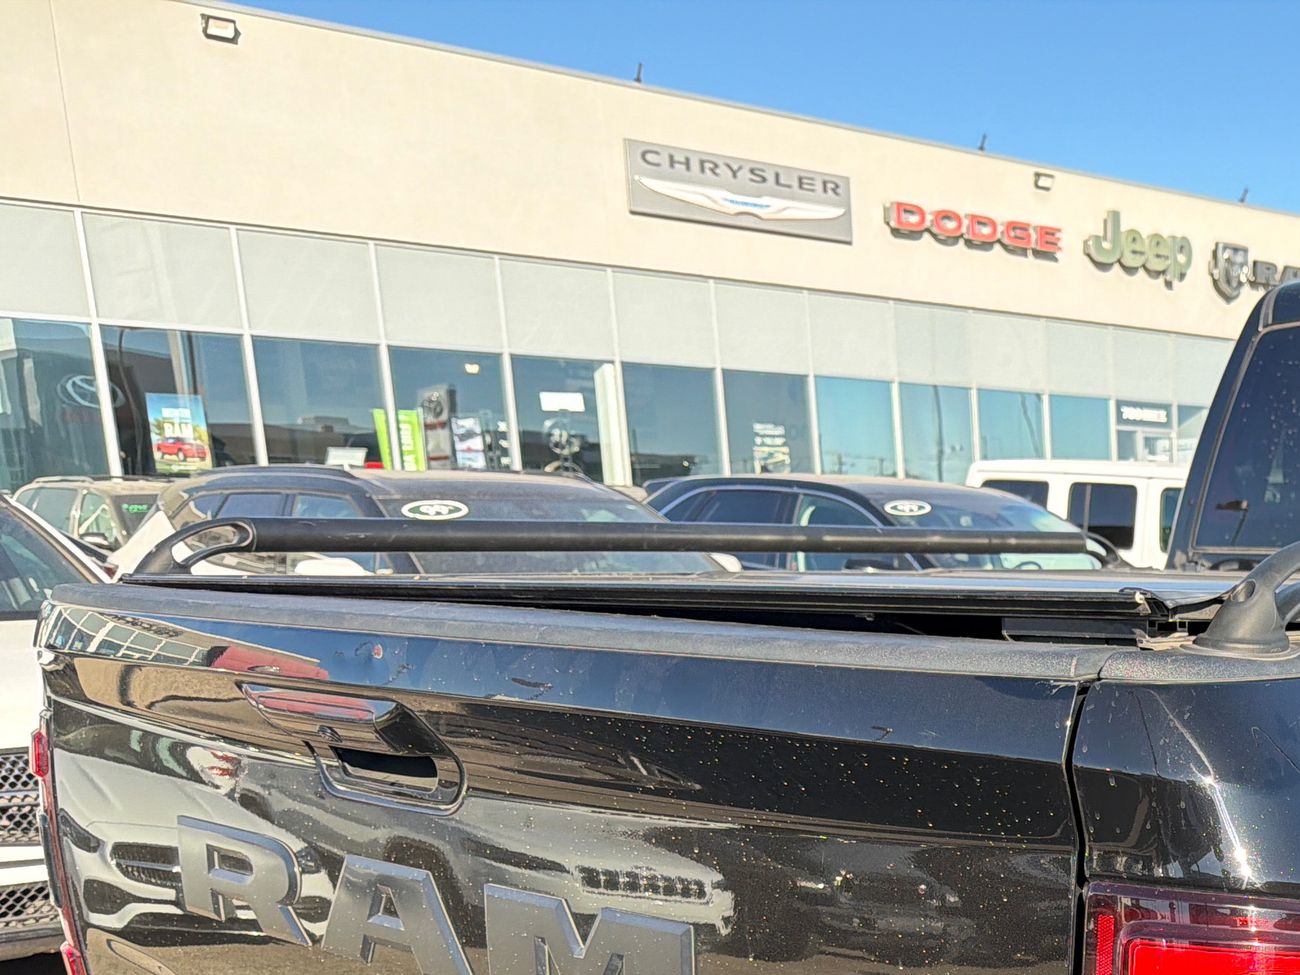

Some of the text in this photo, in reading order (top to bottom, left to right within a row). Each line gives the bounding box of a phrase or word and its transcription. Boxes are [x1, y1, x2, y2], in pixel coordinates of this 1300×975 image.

[640, 149, 842, 196] CHRYSLER
[888, 201, 1062, 255] DODGE
[1084, 210, 1193, 282] Jeep
